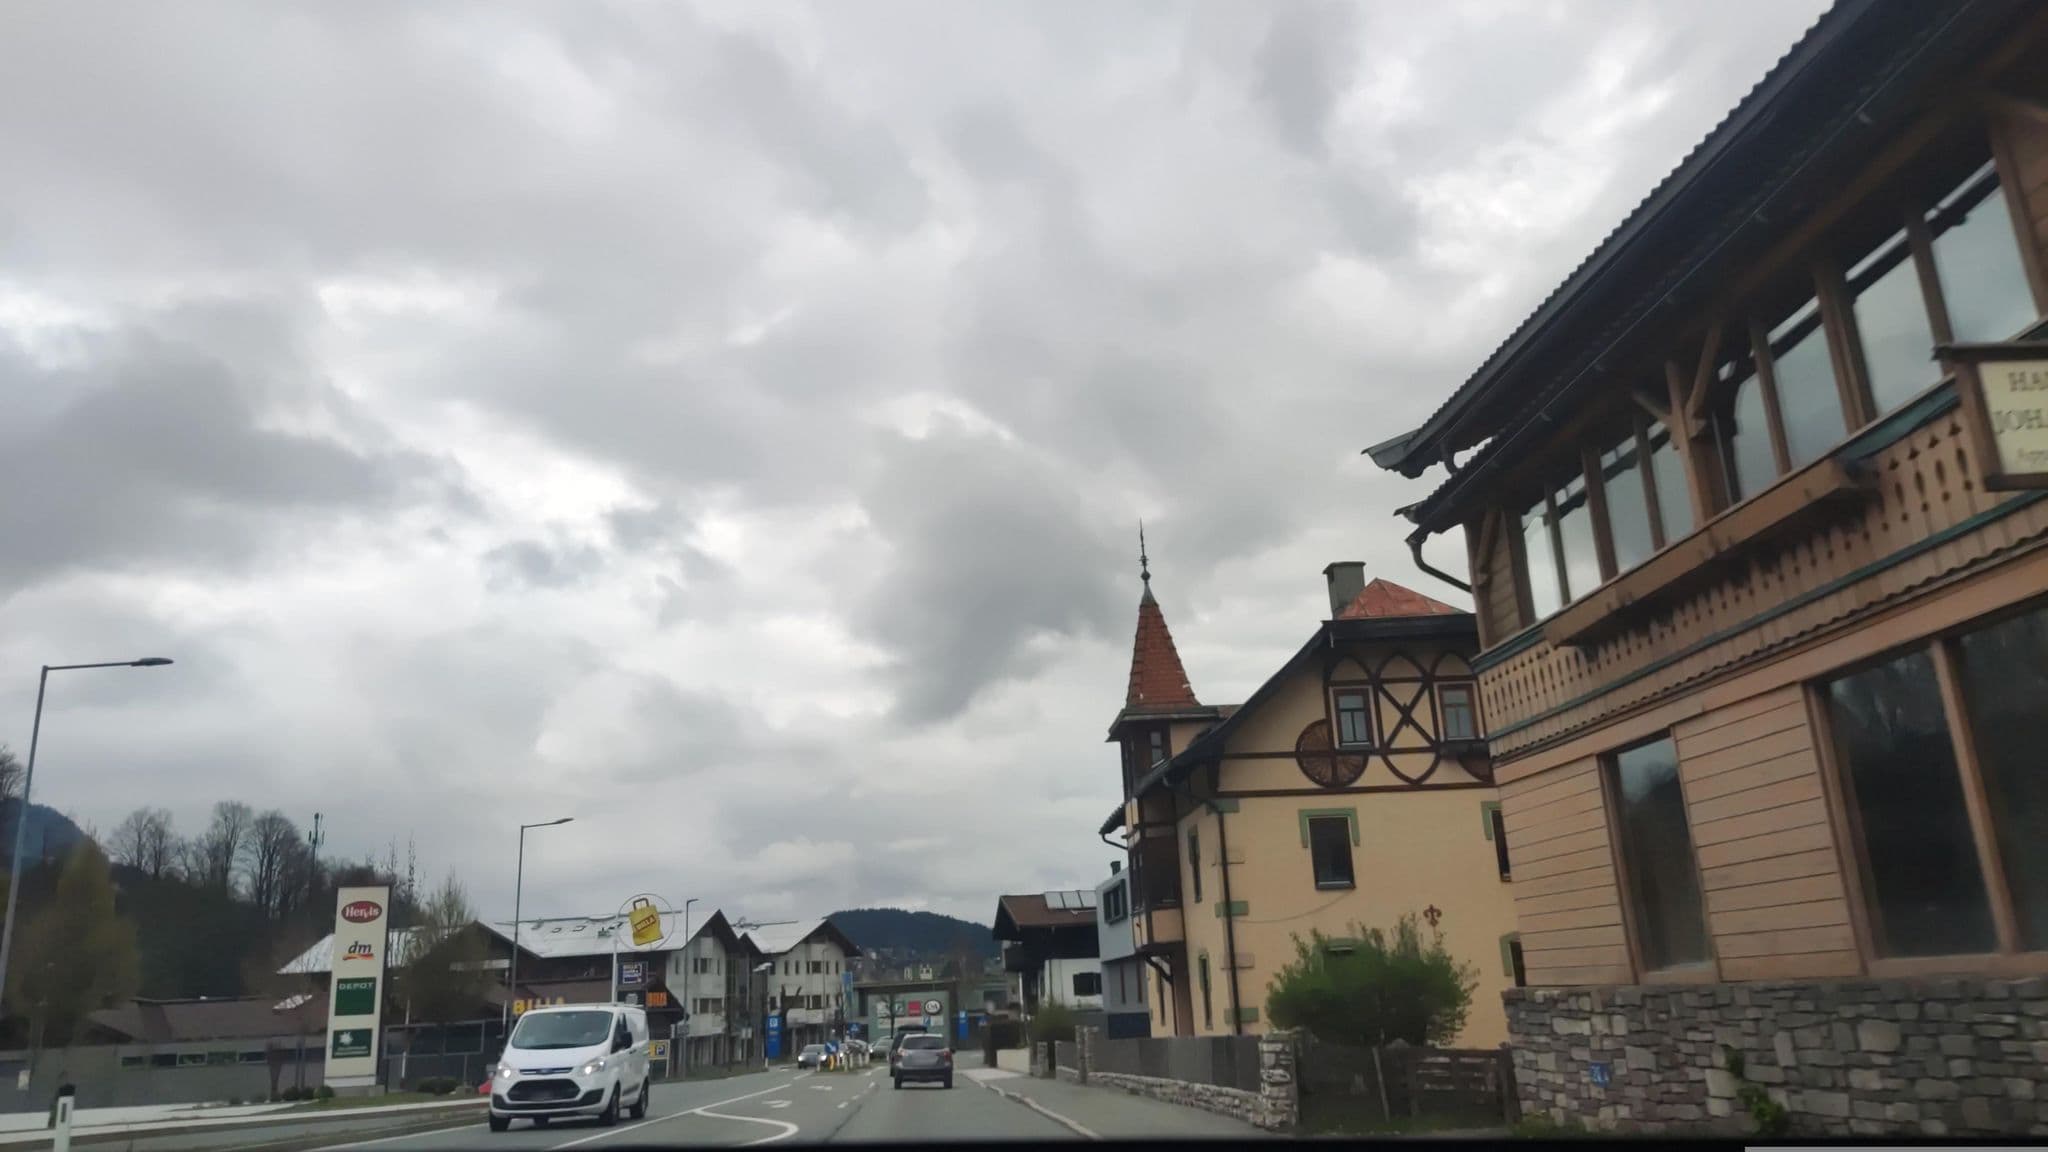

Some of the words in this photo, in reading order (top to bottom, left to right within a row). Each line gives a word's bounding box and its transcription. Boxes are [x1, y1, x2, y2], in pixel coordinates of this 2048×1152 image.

[1993, 408, 2048, 433] JOH
[345, 905, 379, 919] Hervis
[348, 941, 372, 955] dm
[338, 982, 374, 991] DEPOT
